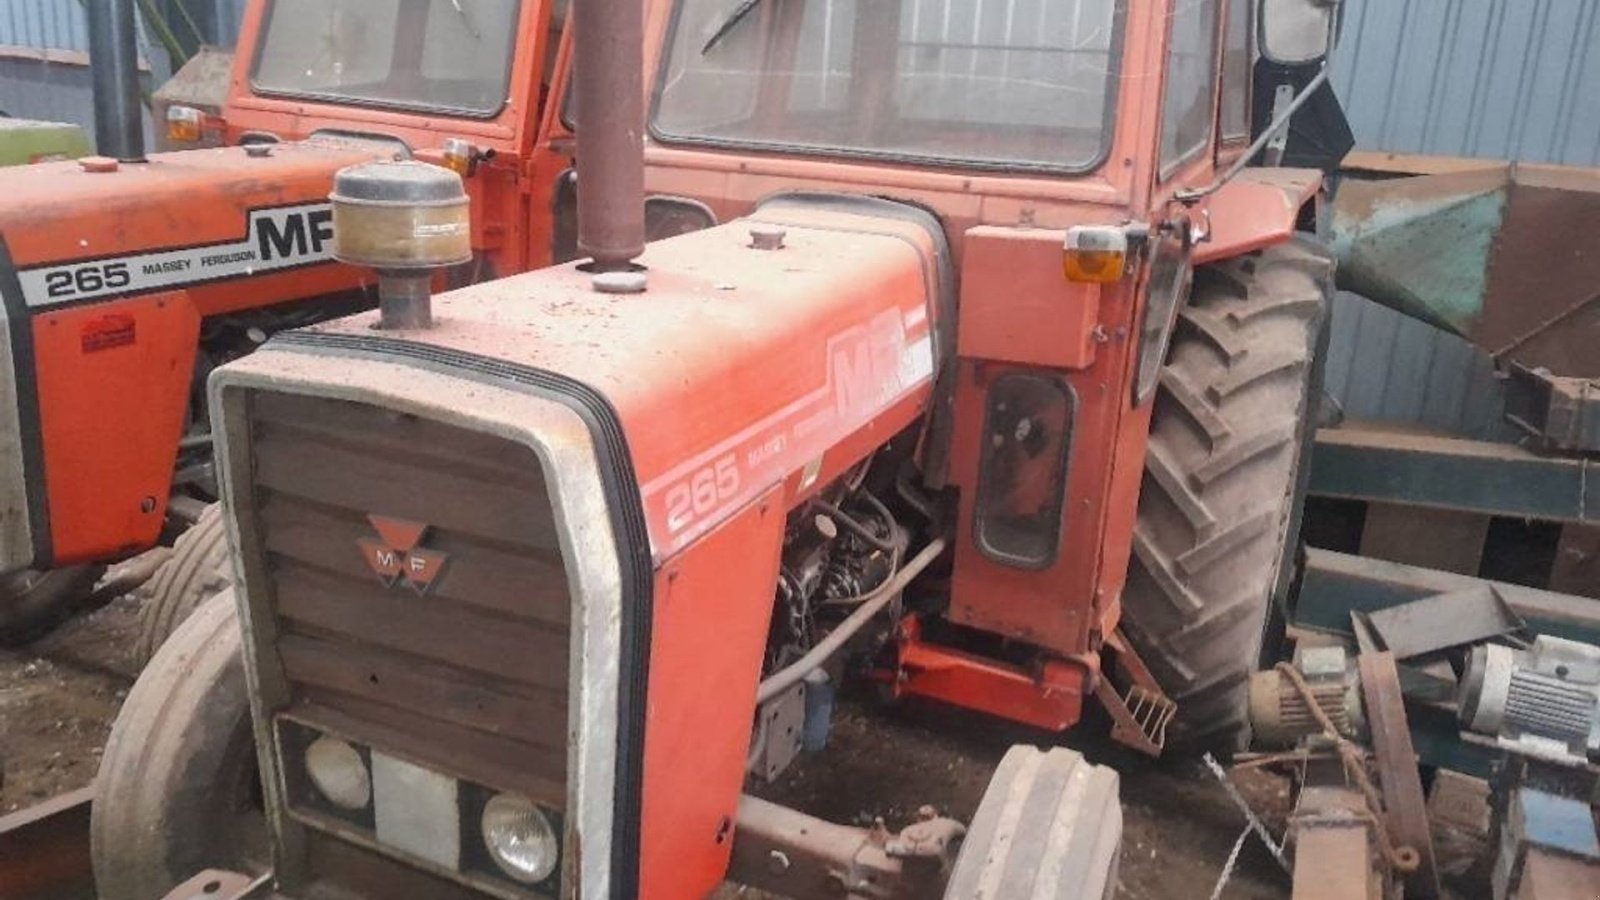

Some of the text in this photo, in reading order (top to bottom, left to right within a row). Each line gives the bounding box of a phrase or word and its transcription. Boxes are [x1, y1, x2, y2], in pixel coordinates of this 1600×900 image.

[45, 209, 333, 297] 265 MASSEY FERGUSON MF
[665, 452, 740, 534] 265
